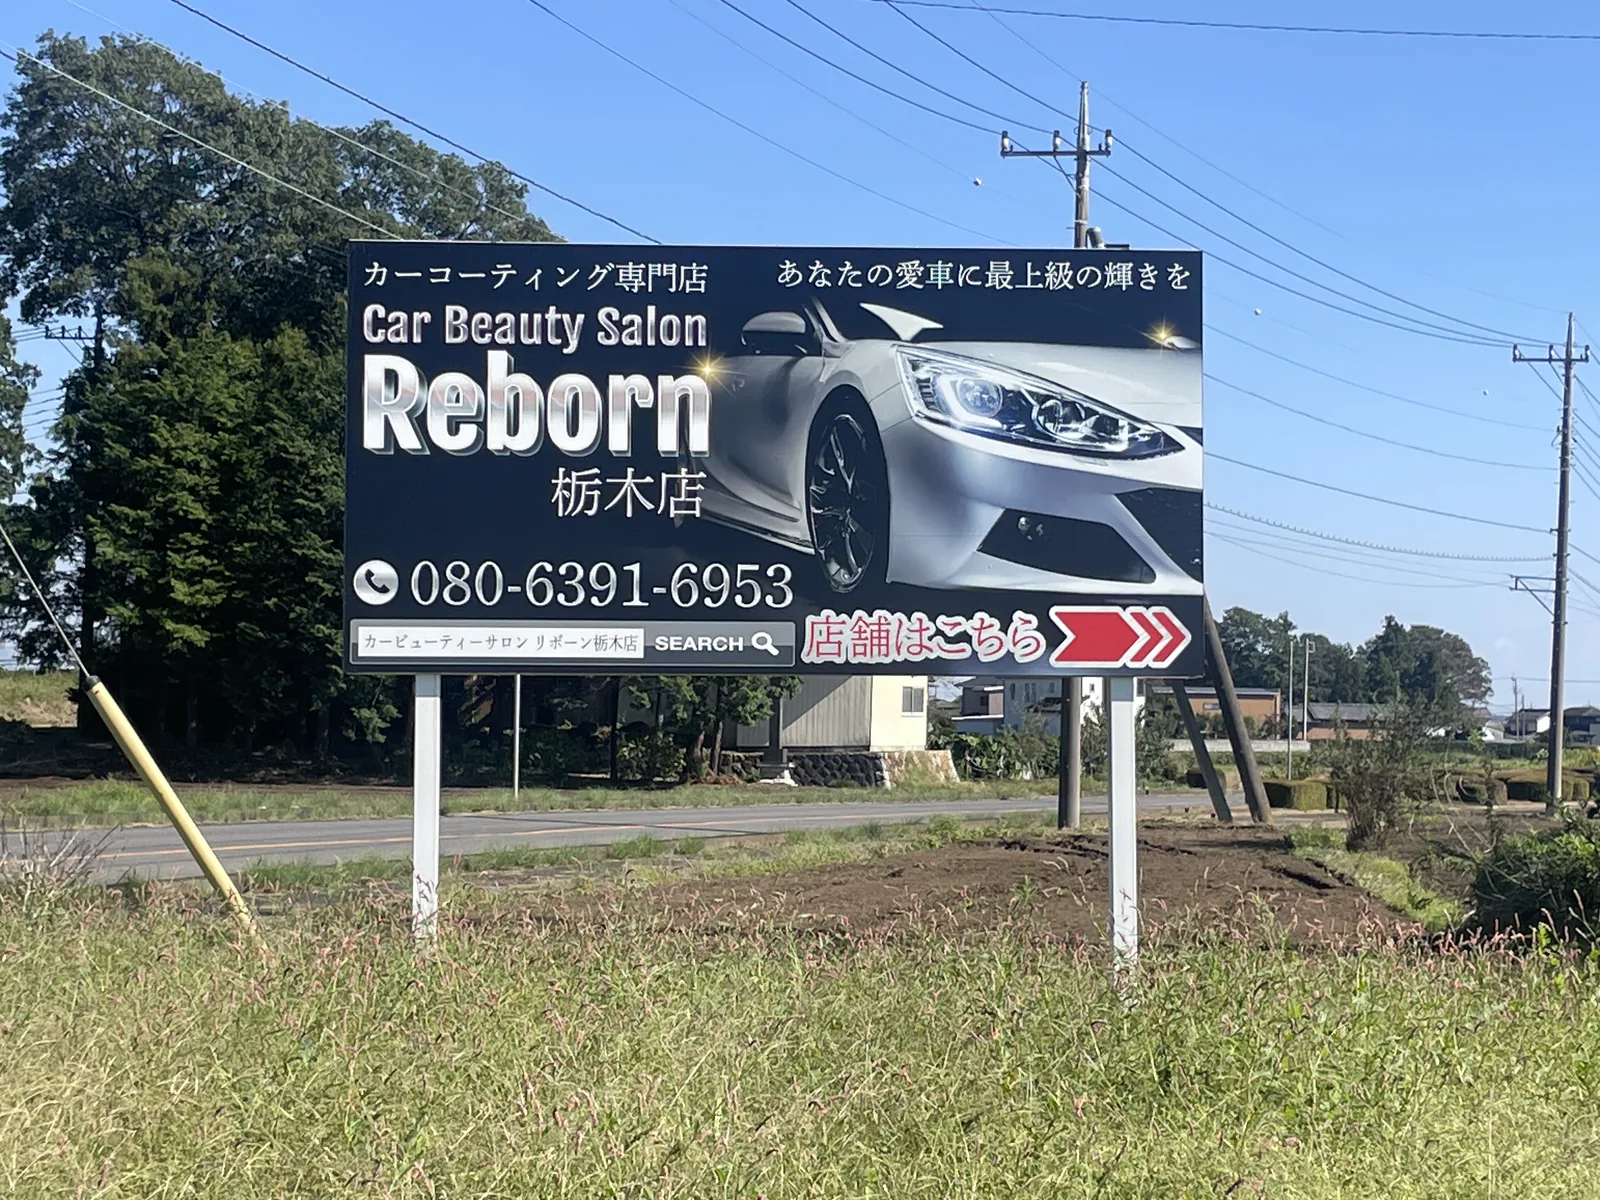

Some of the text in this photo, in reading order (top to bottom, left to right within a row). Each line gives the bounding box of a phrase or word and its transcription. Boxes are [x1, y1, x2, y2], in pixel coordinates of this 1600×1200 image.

[363, 262, 708, 293] カーコーティング専門店
[777, 260, 1191, 291] あなたの愛車に最上級の輝きを
[363, 304, 707, 355] Car Beauty Salon
[363, 350, 712, 457] Reborn
[551, 467, 706, 519] 栃木店
[411, 560, 794, 609] 080-6391-6953
[655, 635, 744, 652] SEARCH
[803, 610, 1045, 662] 店舗はこちら
